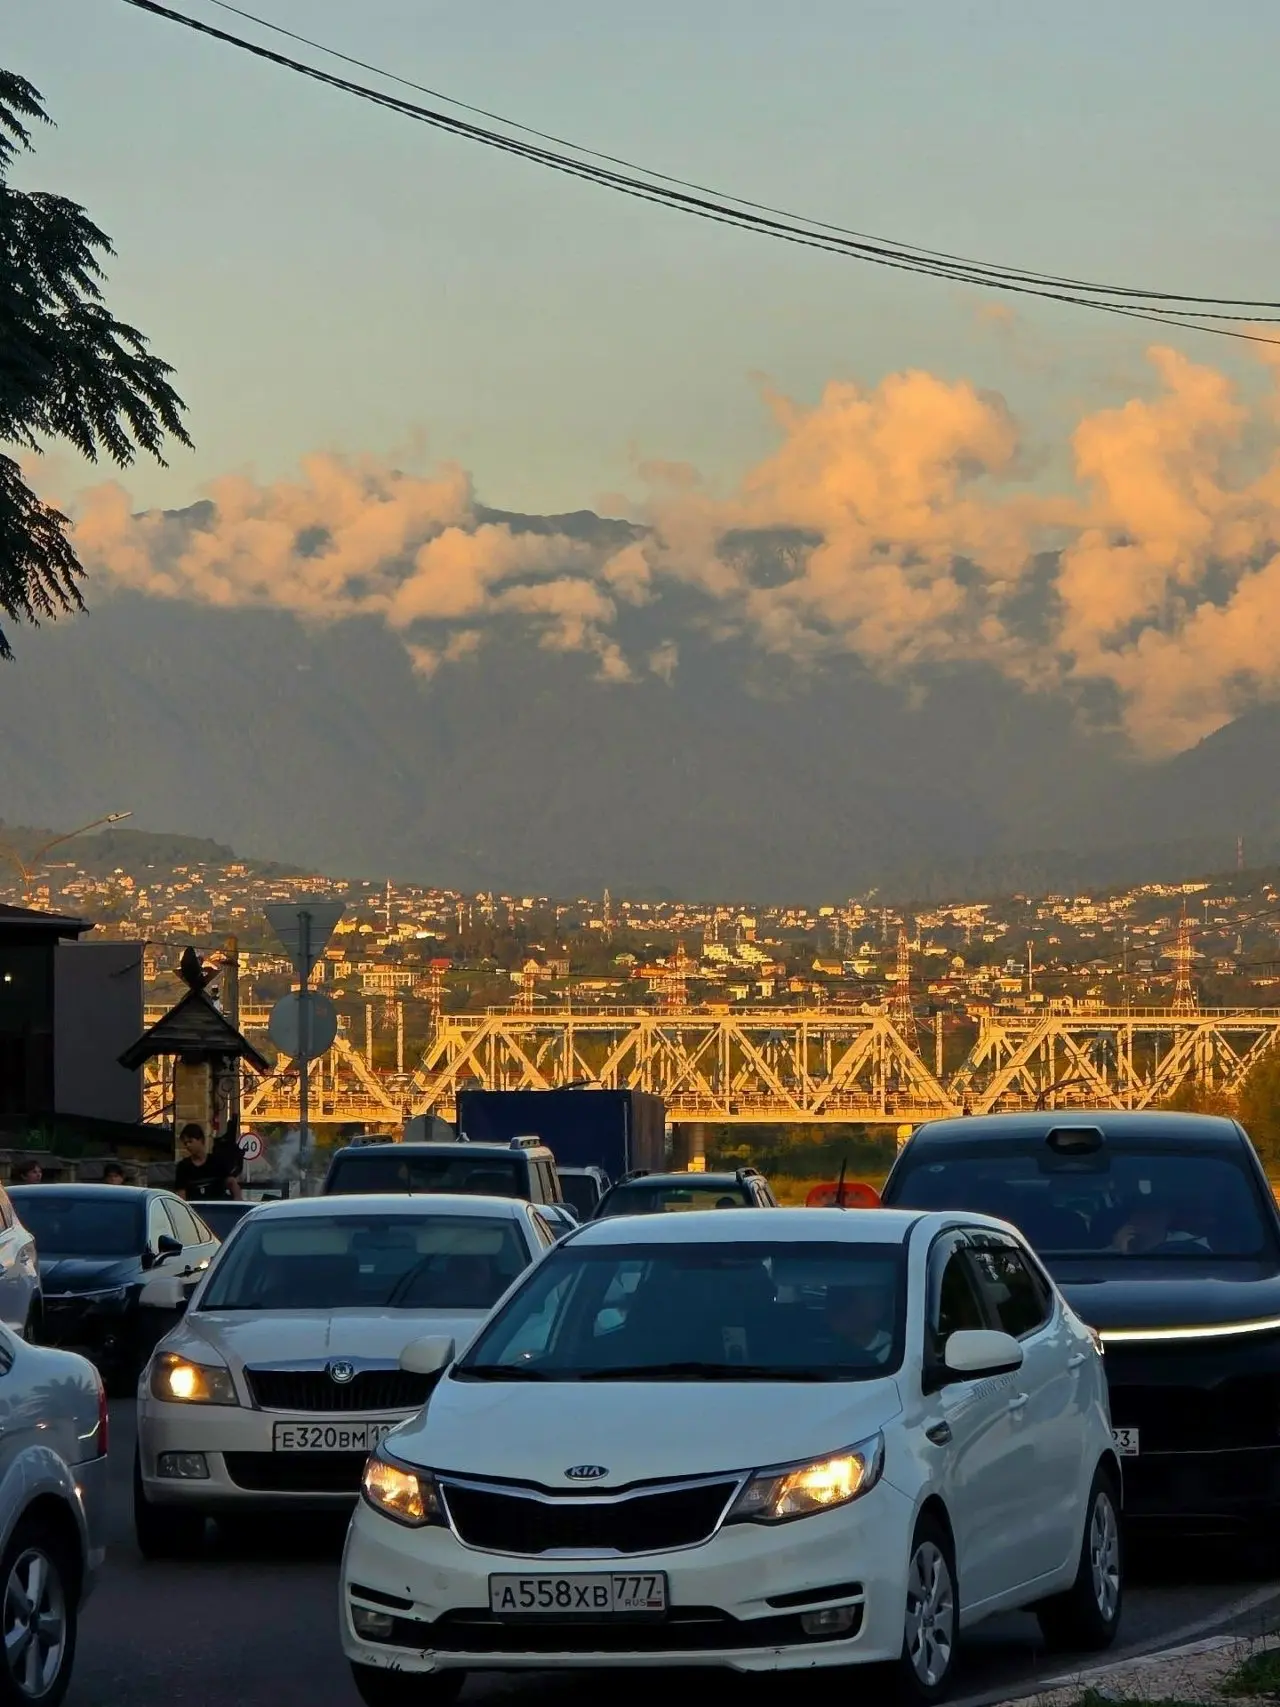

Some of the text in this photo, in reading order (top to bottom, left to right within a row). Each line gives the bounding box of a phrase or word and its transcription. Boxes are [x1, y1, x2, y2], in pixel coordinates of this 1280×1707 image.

[242, 1141, 258, 1152] 40
[282, 1427, 366, 1448] Е320ВМ
[570, 1466, 601, 1476] KIA
[501, 1577, 657, 1609] А558ХВ 777
[625, 1598, 646, 1607] RUS
